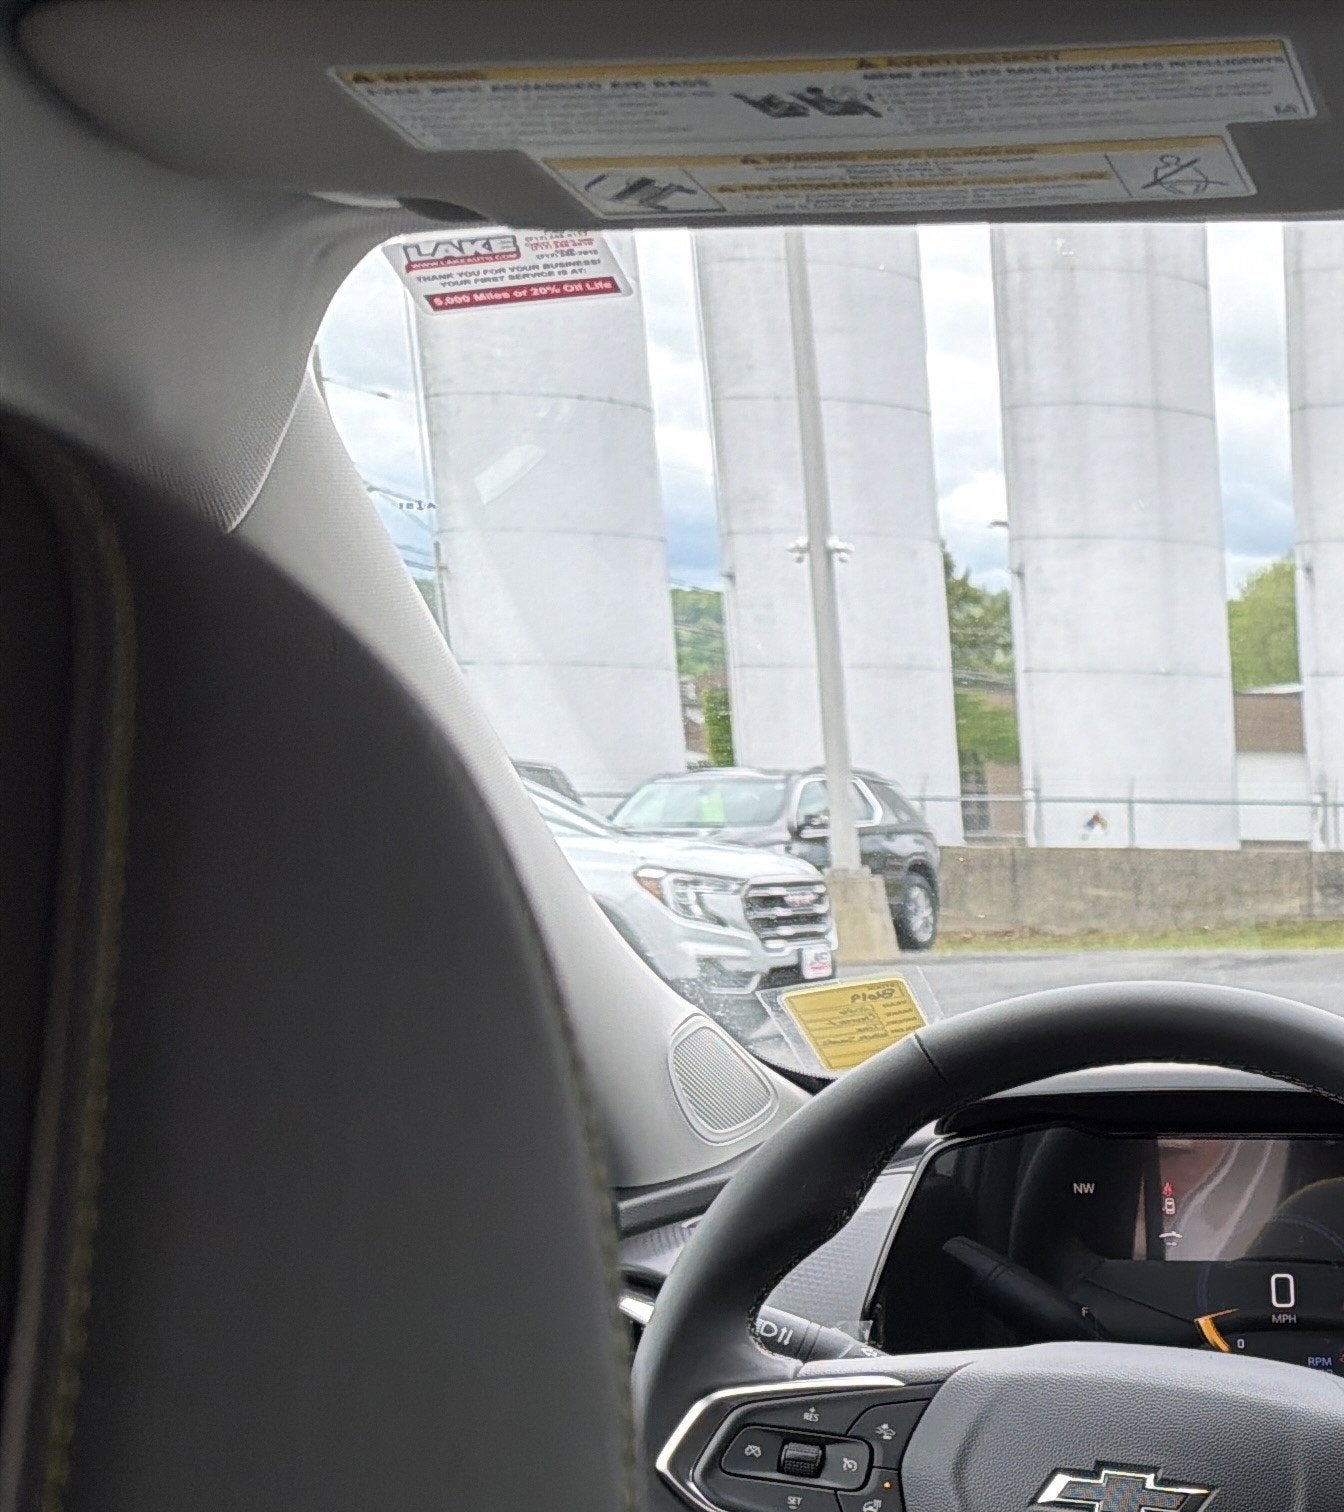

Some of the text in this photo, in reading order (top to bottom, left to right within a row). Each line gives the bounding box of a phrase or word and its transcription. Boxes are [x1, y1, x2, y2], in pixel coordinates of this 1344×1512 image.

[403, 235, 518, 262] LAKE
[417, 259, 601, 282] THANK YOU FOR YOUR BUSINESS!
[440, 279, 471, 287] YOUR
[474, 276, 504, 284] FIRST
[508, 270, 555, 280] SERVICE
[434, 280, 613, 306] 5,000 Miles or 20% Oil Life
[1073, 1183, 1095, 1194] NW
[1271, 1273, 1295, 1308] 0
[1272, 1314, 1296, 1324] MPH
[1237, 1339, 1245, 1349] 0
[1308, 1356, 1332, 1367] RPM
